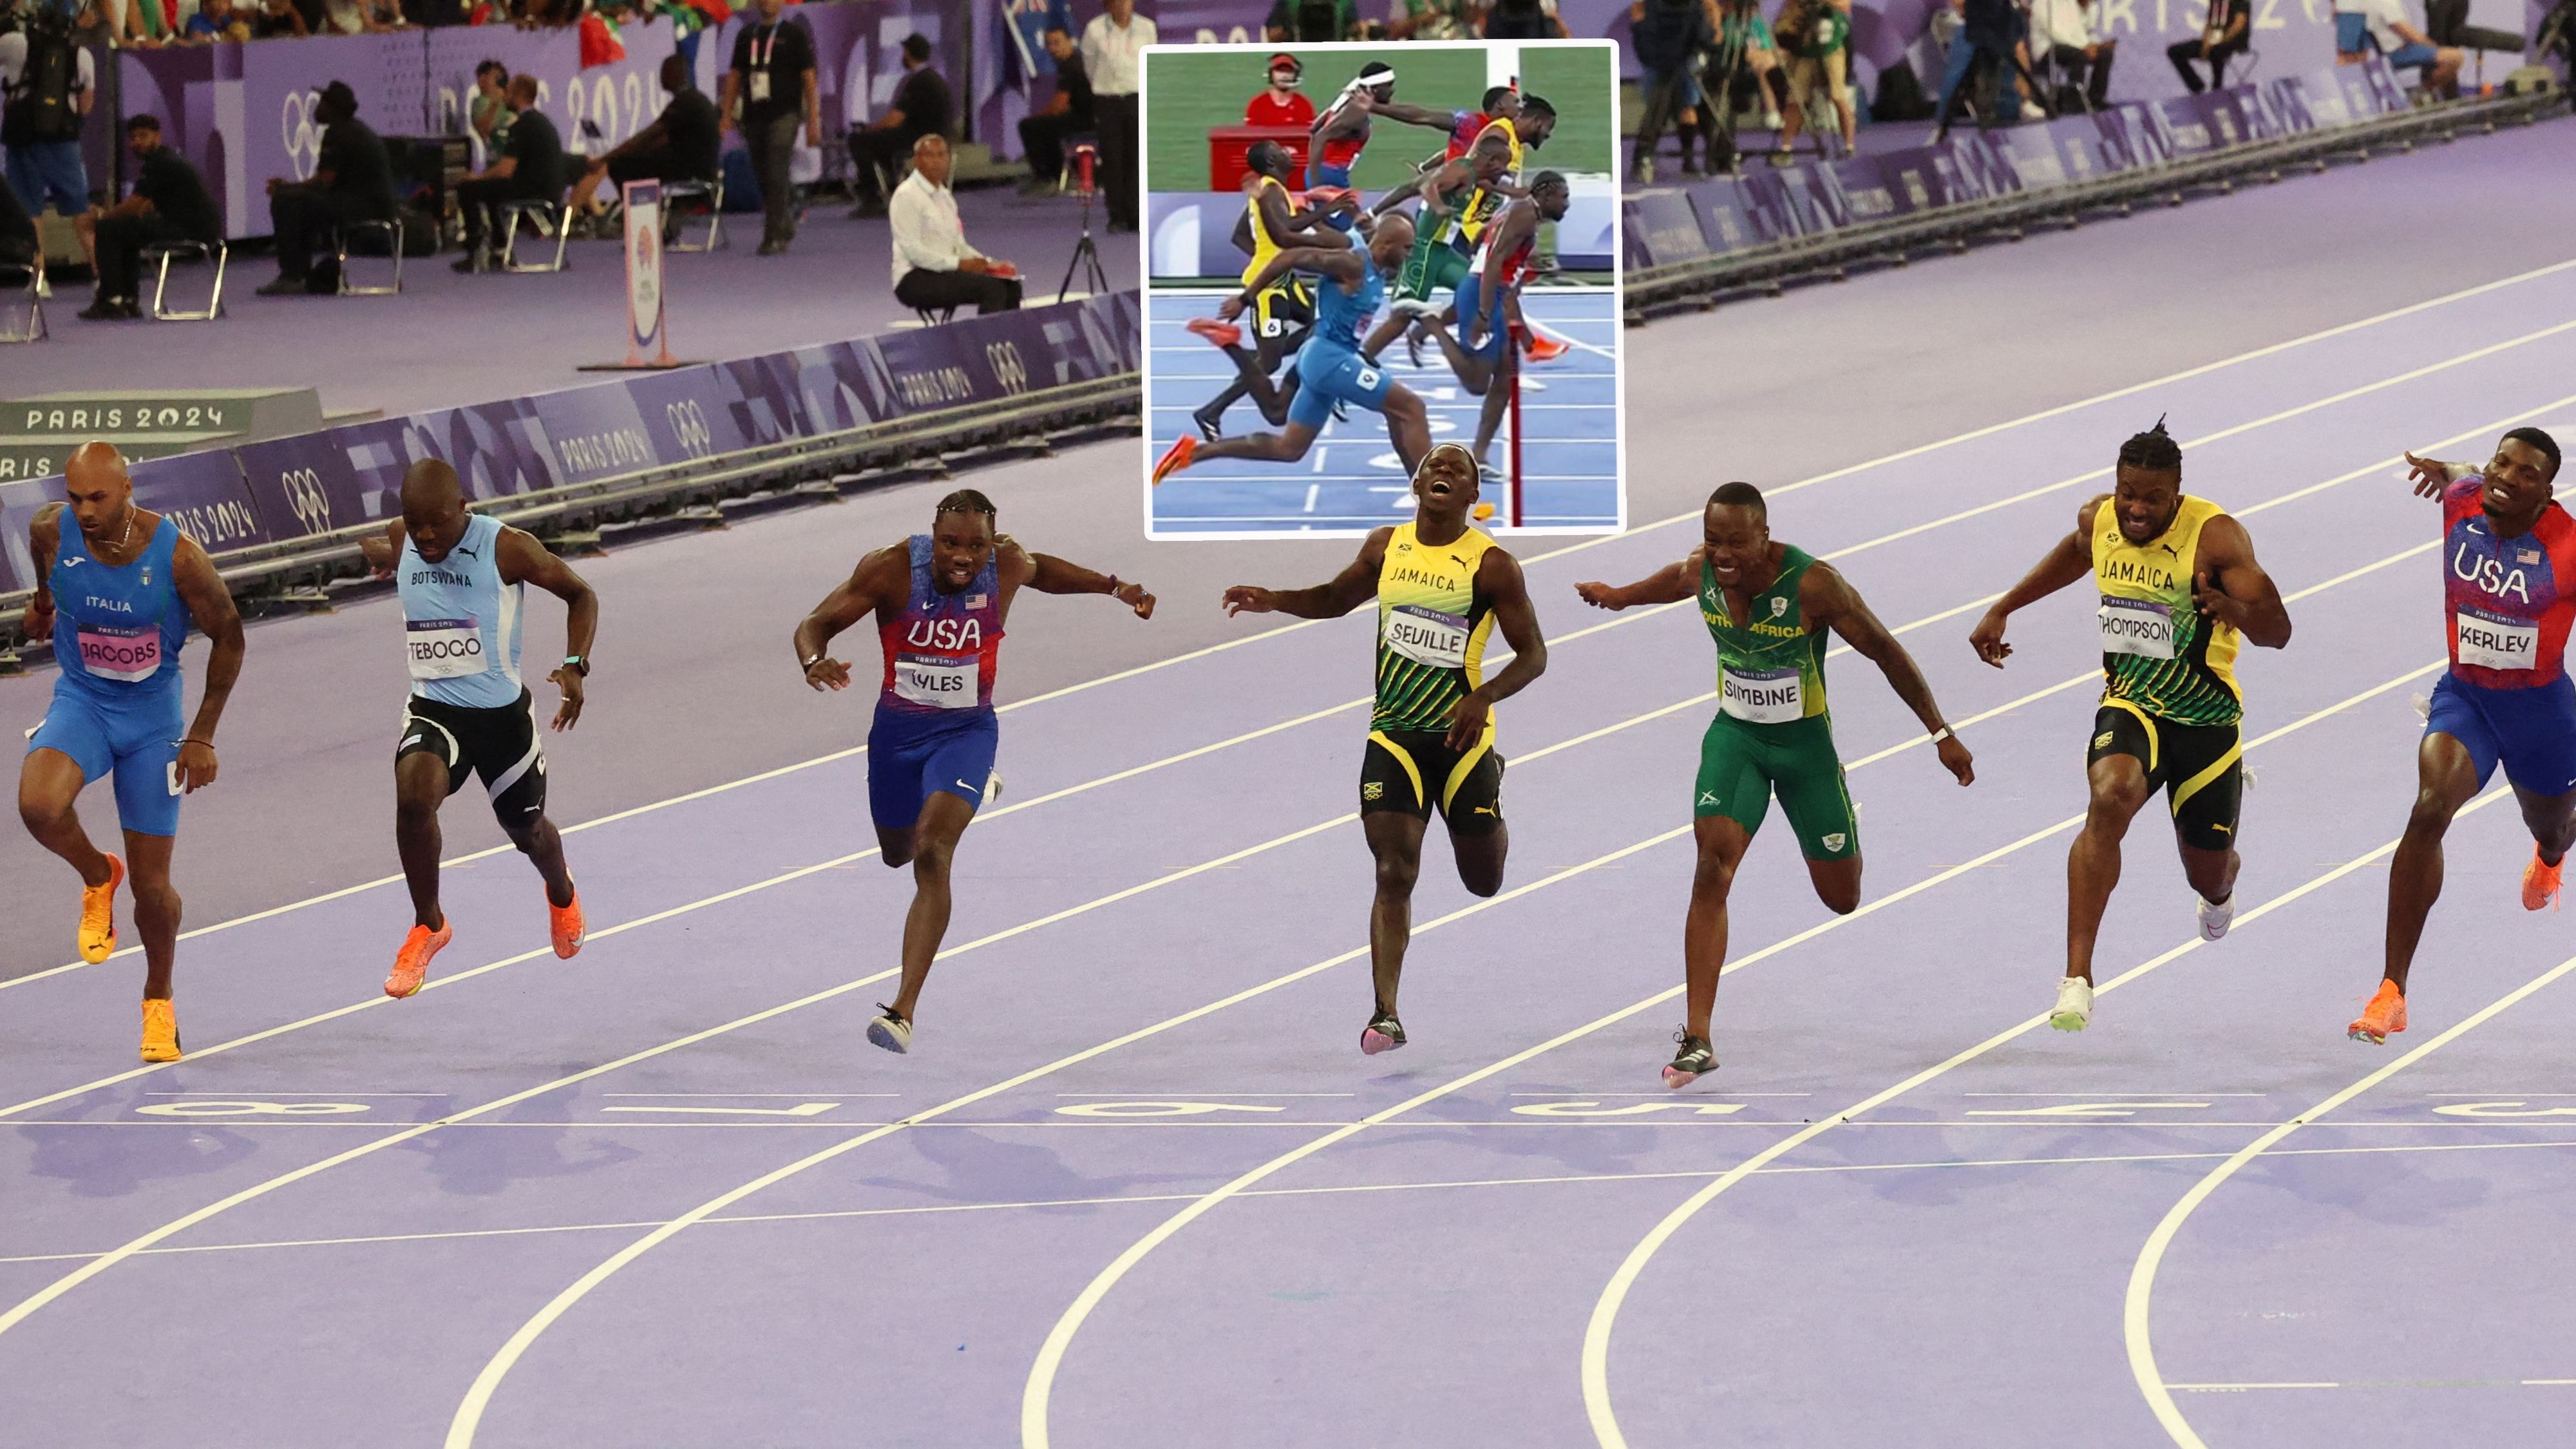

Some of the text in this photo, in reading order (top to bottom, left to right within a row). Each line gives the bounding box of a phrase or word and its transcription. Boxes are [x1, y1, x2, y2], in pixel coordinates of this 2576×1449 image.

[1267, 323, 1277, 333] 6
[27, 407, 222, 430] PARIS 2024
[560, 428, 649, 474] PARIS 2024
[206, 500, 256, 542] 2024
[412, 571, 473, 587] BOTSWANA
[1390, 567, 1455, 592] JAMAICA
[2101, 560, 2175, 591] JAMAICA
[2454, 542, 2530, 604] USA
[86, 596, 133, 614] ITALIA
[1410, 606, 1450, 623] PARIS 2024
[2111, 598, 2132, 607] PARIS
[1703, 611, 1806, 638] OUTH AFRICA
[2098, 614, 2170, 641] THOMPSON
[2475, 609, 2517, 625] PARIS 2024
[907, 618, 981, 650] USA
[1391, 622, 1462, 654] SEVILLE
[2459, 625, 2530, 653] KERLEY
[81, 641, 156, 665] JACOBS
[409, 637, 482, 660] TEBOGO
[914, 656, 937, 664] PARIS
[911, 669, 964, 692] LYLES
[1725, 679, 1797, 706] SIMBINE
